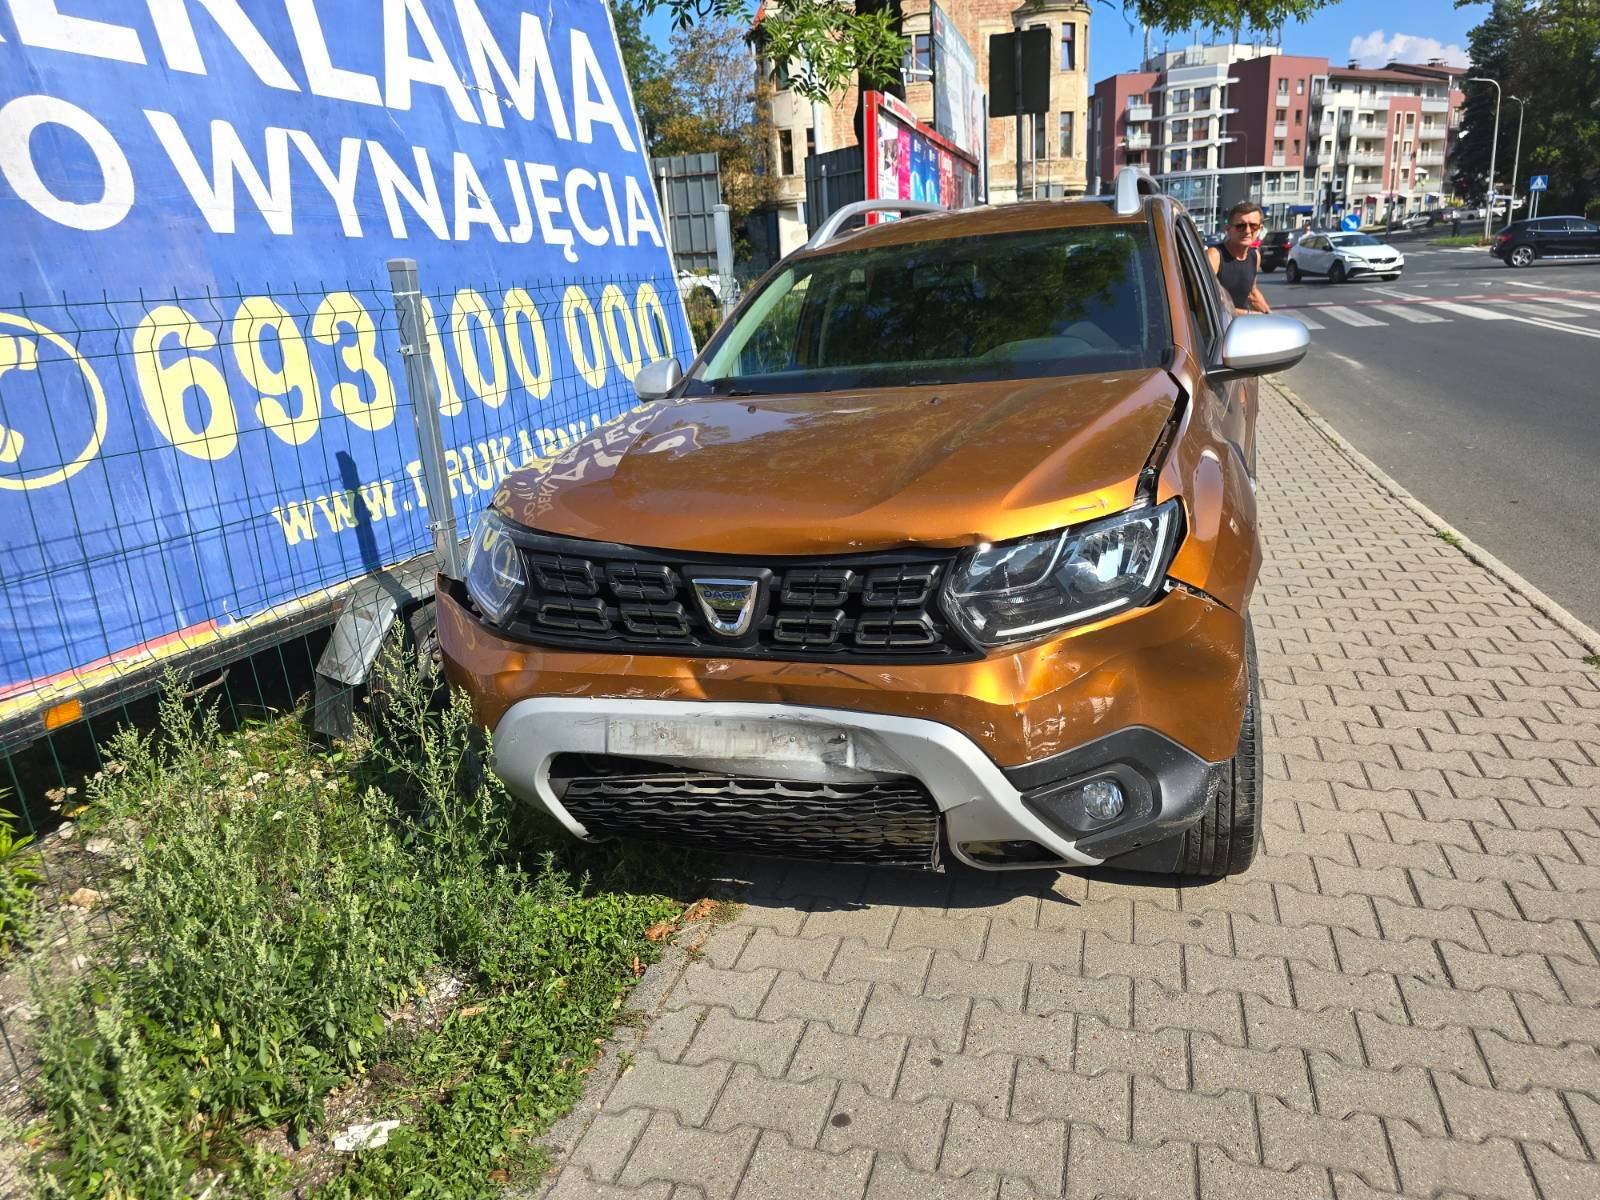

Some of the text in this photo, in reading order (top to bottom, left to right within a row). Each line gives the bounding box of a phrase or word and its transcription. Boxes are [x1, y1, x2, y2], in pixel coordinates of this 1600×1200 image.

[0, 0, 637, 153] LAMA
[142, 109, 665, 263] WYNAJĘCIA
[133, 283, 673, 460] 693 100 000
